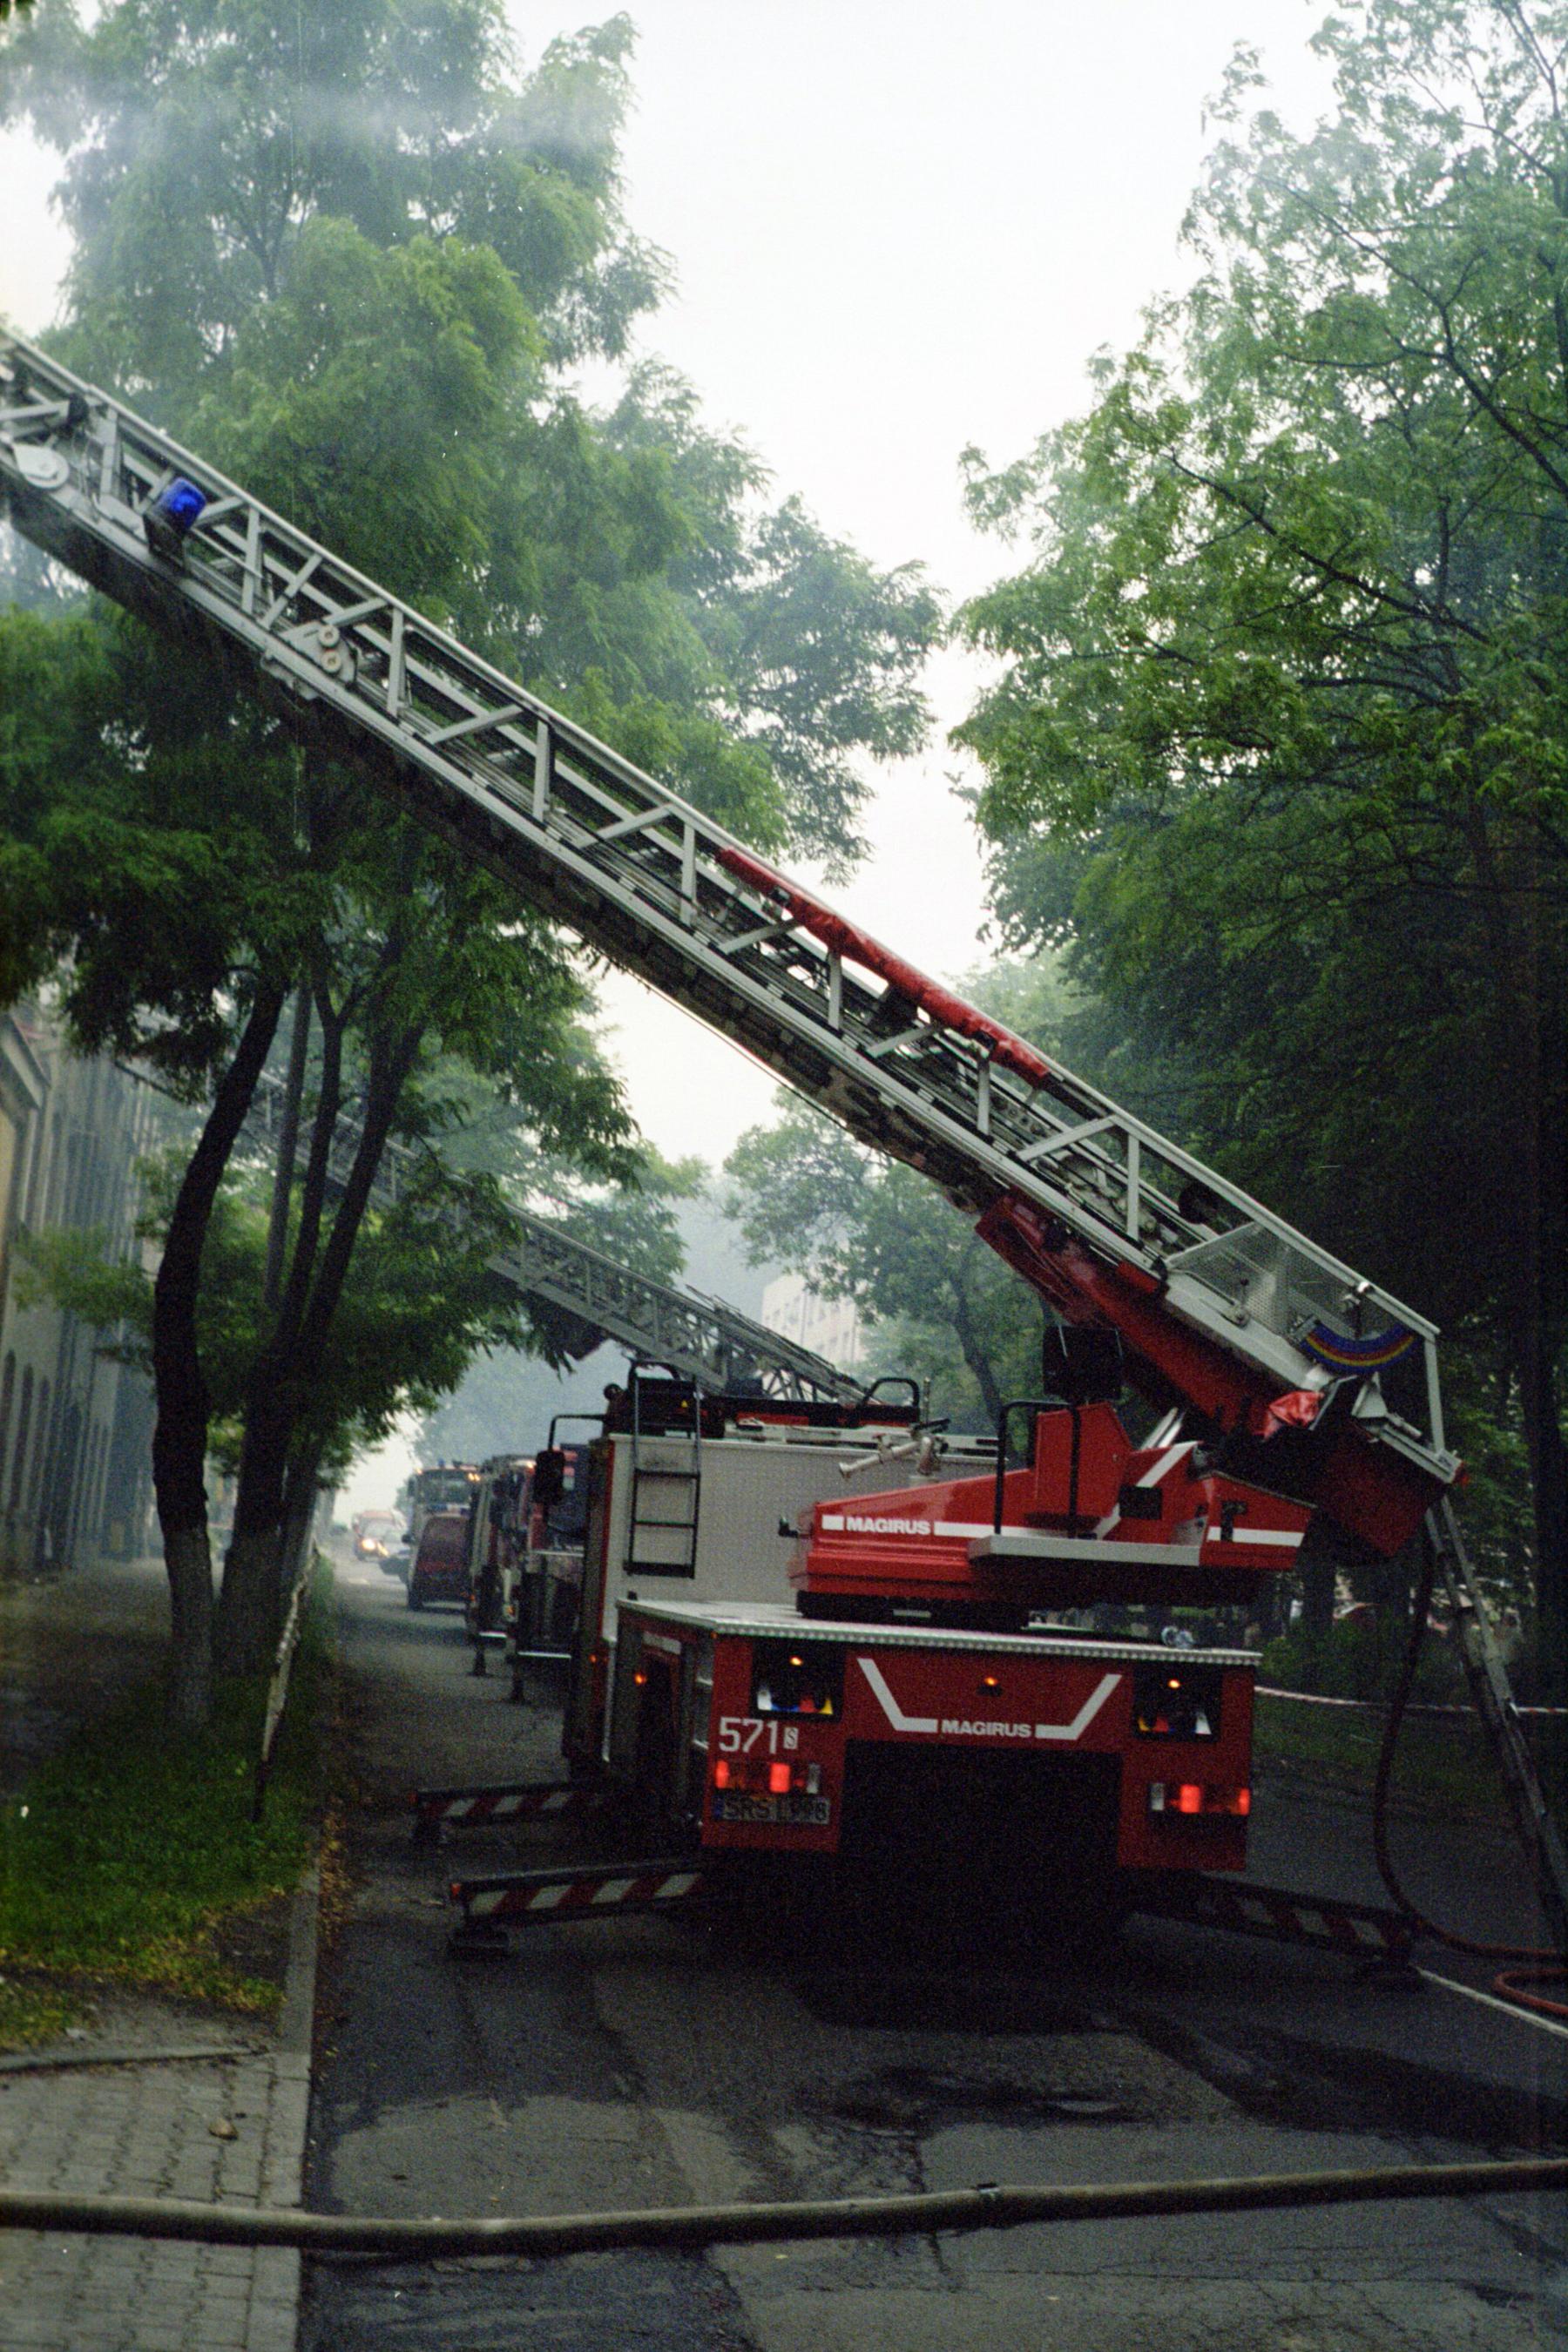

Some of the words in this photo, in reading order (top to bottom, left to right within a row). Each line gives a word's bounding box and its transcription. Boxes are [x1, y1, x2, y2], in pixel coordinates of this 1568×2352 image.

[847, 1517, 931, 1535] MAGIRUS
[719, 1717, 779, 1754] 571
[942, 1720, 1032, 1738] MAGIRUS
